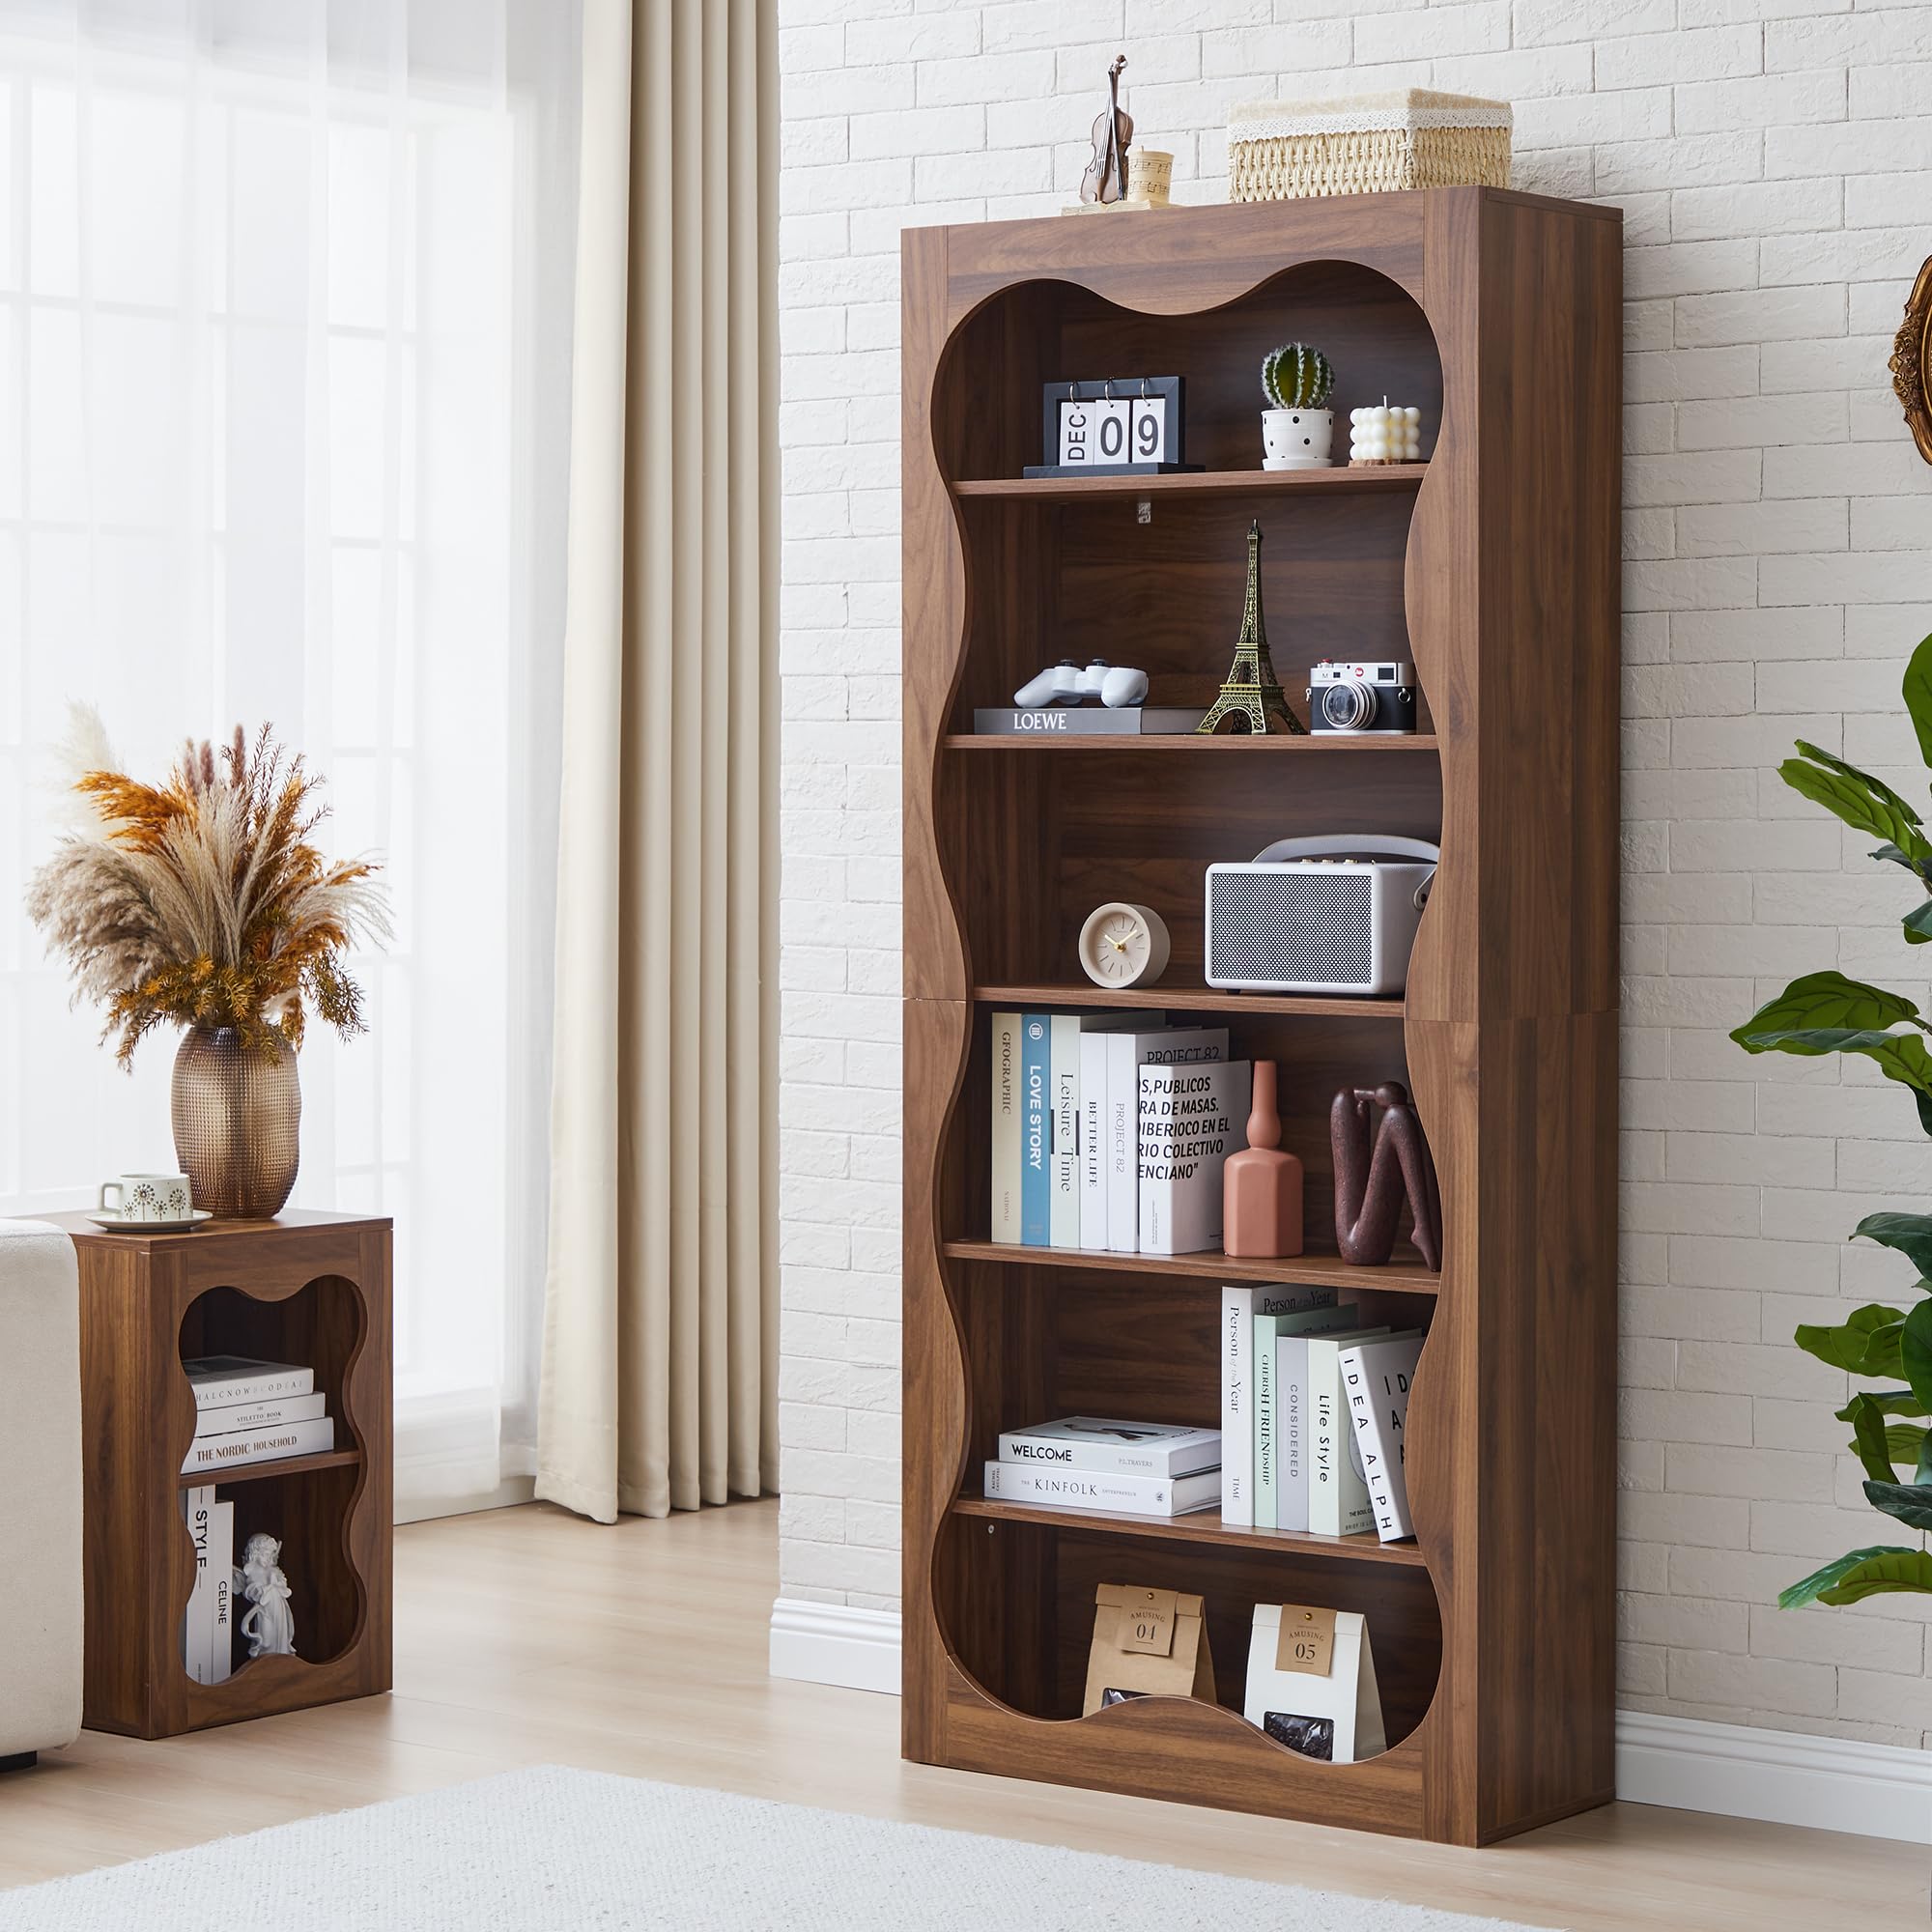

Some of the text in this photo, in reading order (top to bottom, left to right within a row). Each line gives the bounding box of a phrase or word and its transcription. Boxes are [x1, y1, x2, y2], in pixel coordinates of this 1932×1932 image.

[1067, 414, 1087, 460] DEC
[1013, 713, 1067, 729] LOEWE
[1204, 1046, 1220, 1060] 82
[1002, 1031, 1011, 1115] GEOGRAPHIC
[1139, 1076, 1211, 1096] S,PUBLICOS
[1029, 1065, 1042, 1171] LOVE STORY
[1161, 1101, 1179, 1116] DE
[1180, 1097, 1219, 1115] MASAS.
[1061, 1073, 1074, 1192] Leisure Time
[1114, 1103, 1125, 1173] PROJECT 82
[1138, 1117, 1231, 1137] IBERIOCO EN EL
[1089, 1101, 1097, 1187] BETTER LIFE
[1163, 1139, 1224, 1158] COLECTIVO
[1264, 1297, 1296, 1313] Person
[1310, 1290, 1331, 1306] Year
[1230, 1306, 1240, 1356] Person
[1231, 1380, 1241, 1413] Year
[1261, 1353, 1270, 1486] CHERISH FRIENDSHIP
[1290, 1383, 1298, 1478] CONSIDERED
[197, 1435, 298, 1462] THE NORDIC HOUSEHOLD
[1011, 1443, 1072, 1462] WELCOME
[1317, 1394, 1330, 1483] Life Style
[1344, 1358, 1393, 1529] IDEA ALPH
[1035, 1478, 1098, 1496] KINFOLK
[218, 1580, 228, 1625] CELINE
[1130, 1611, 1166, 1623] AMUSING
[1290, 1630, 1325, 1642] AMUSING
[1295, 1642, 1316, 1661] 05
